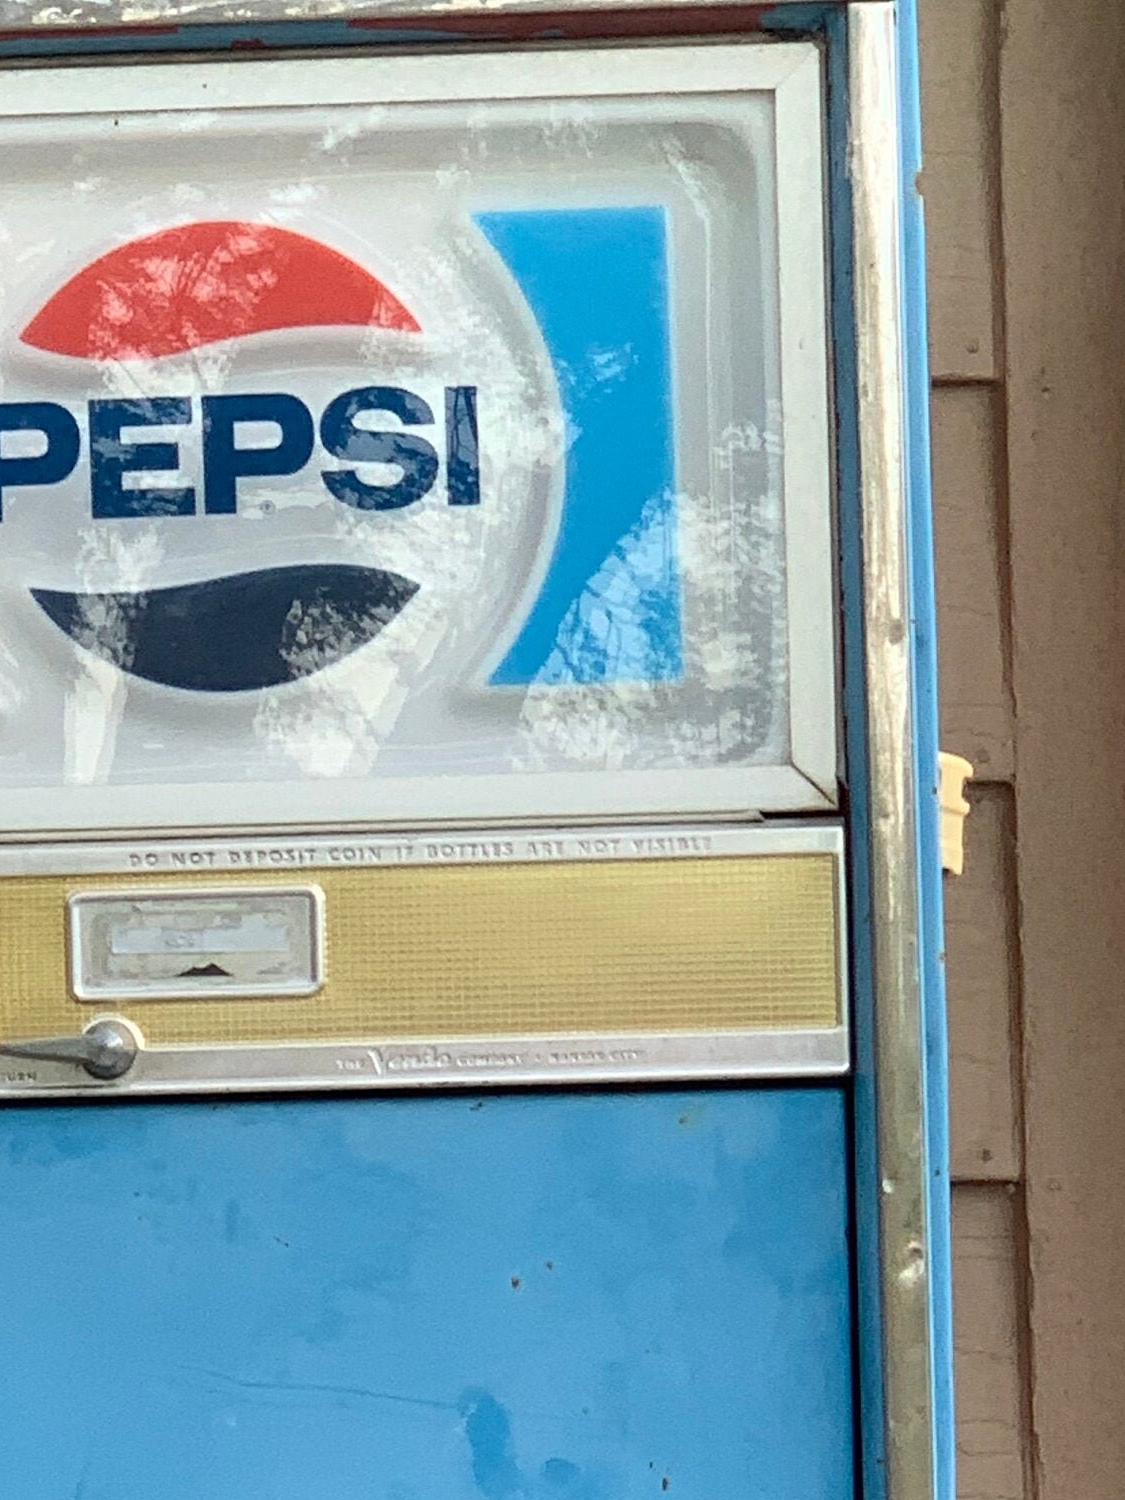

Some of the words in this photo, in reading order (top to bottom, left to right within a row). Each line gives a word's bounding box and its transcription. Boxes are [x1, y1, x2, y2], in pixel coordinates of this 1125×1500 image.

[128, 853, 159, 868] DO
[171, 851, 217, 866] NOT
[227, 848, 317, 865] DEPOSIT
[328, 846, 383, 862] COIN
[425, 841, 515, 859] BOTTLES
[526, 840, 566, 856] ARE
[578, 838, 622, 855] NOT
[632, 836, 714, 854] VISIBLE
